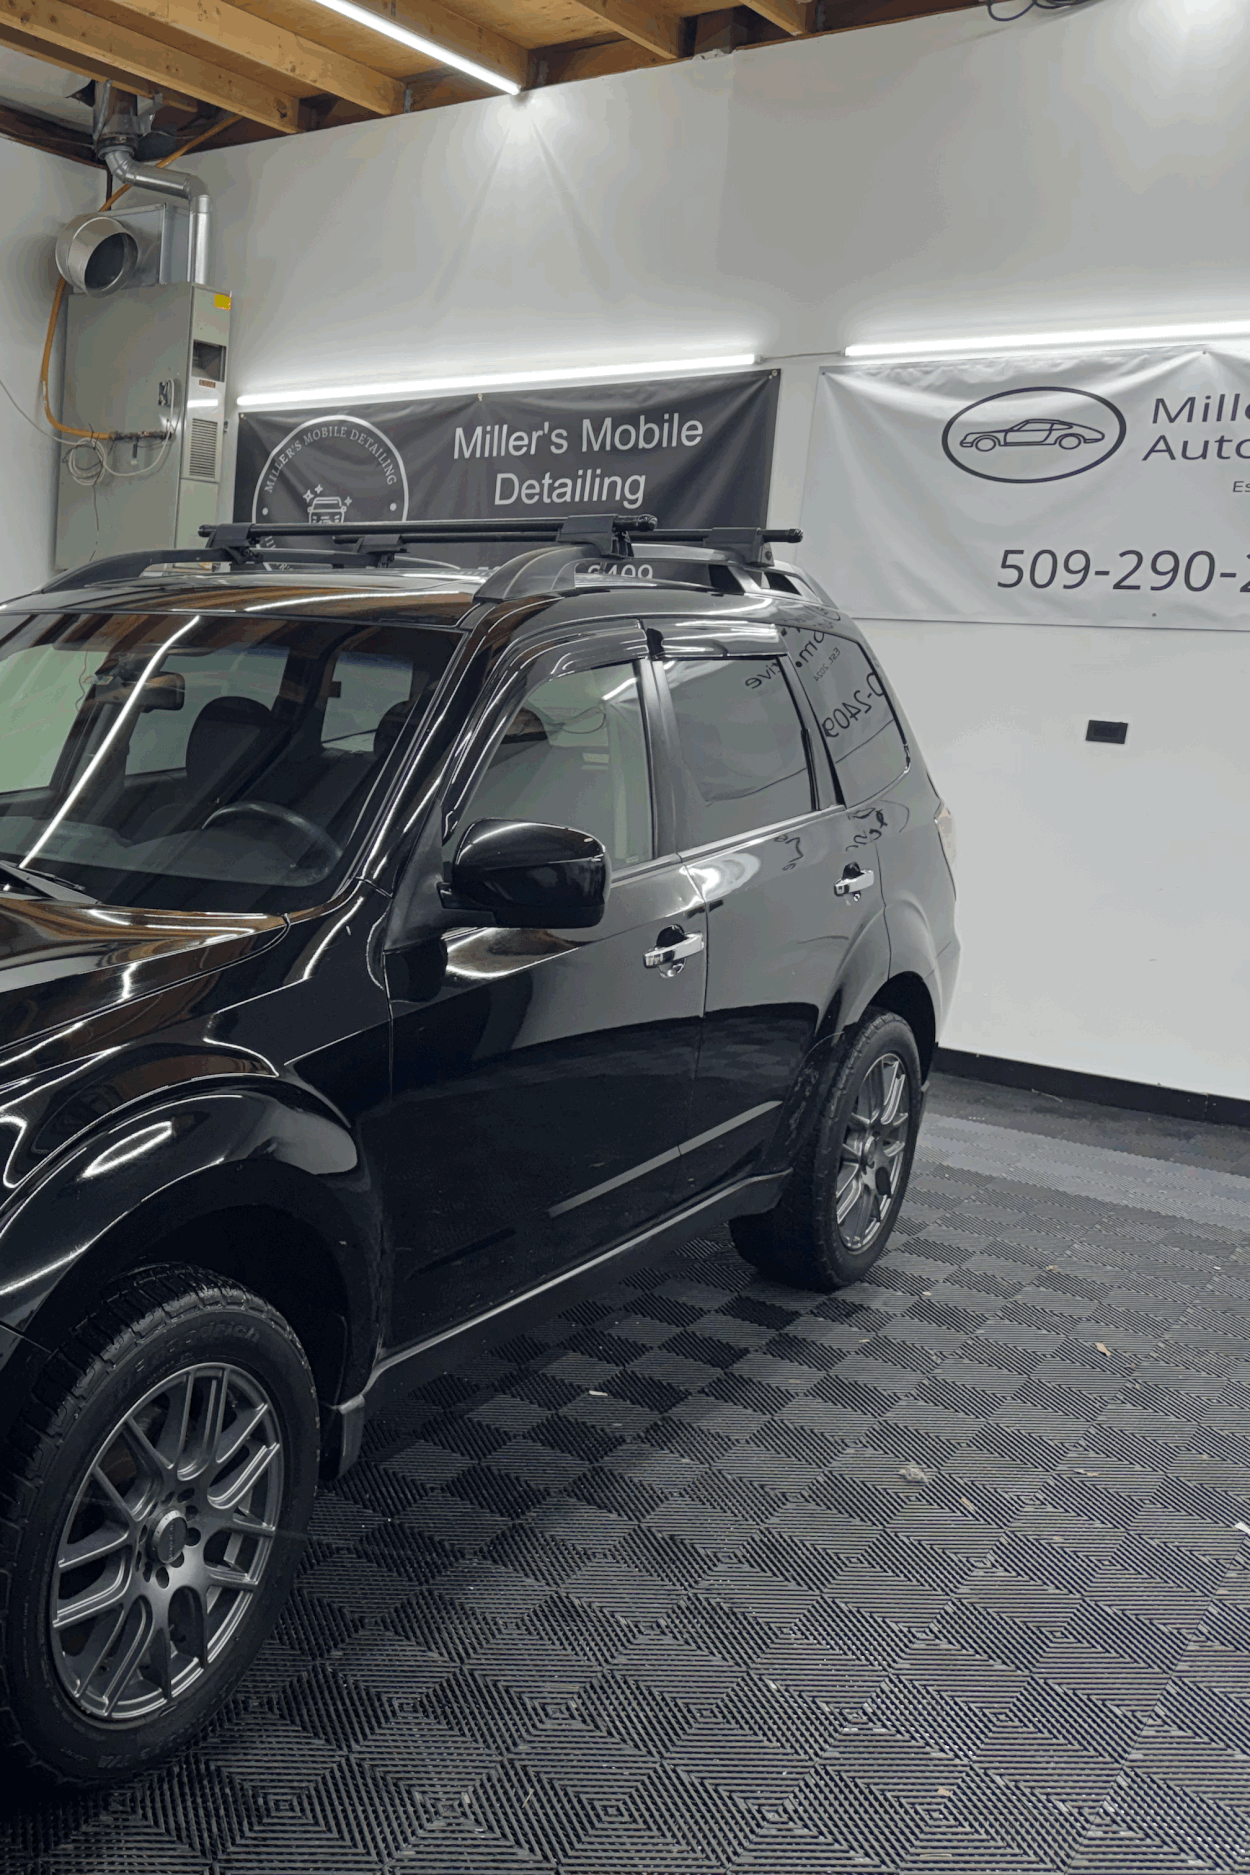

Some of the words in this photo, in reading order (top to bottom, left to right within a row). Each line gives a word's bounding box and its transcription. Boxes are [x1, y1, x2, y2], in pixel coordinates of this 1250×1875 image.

[1152, 393, 1250, 424] Mill
[453, 421, 569, 460] Miller's
[581, 412, 704, 453] Mobile
[264, 440, 303, 493] MILLER'S
[302, 426, 348, 446] MOBILE
[349, 429, 397, 486] DETAILING
[494, 468, 647, 510] Detailing
